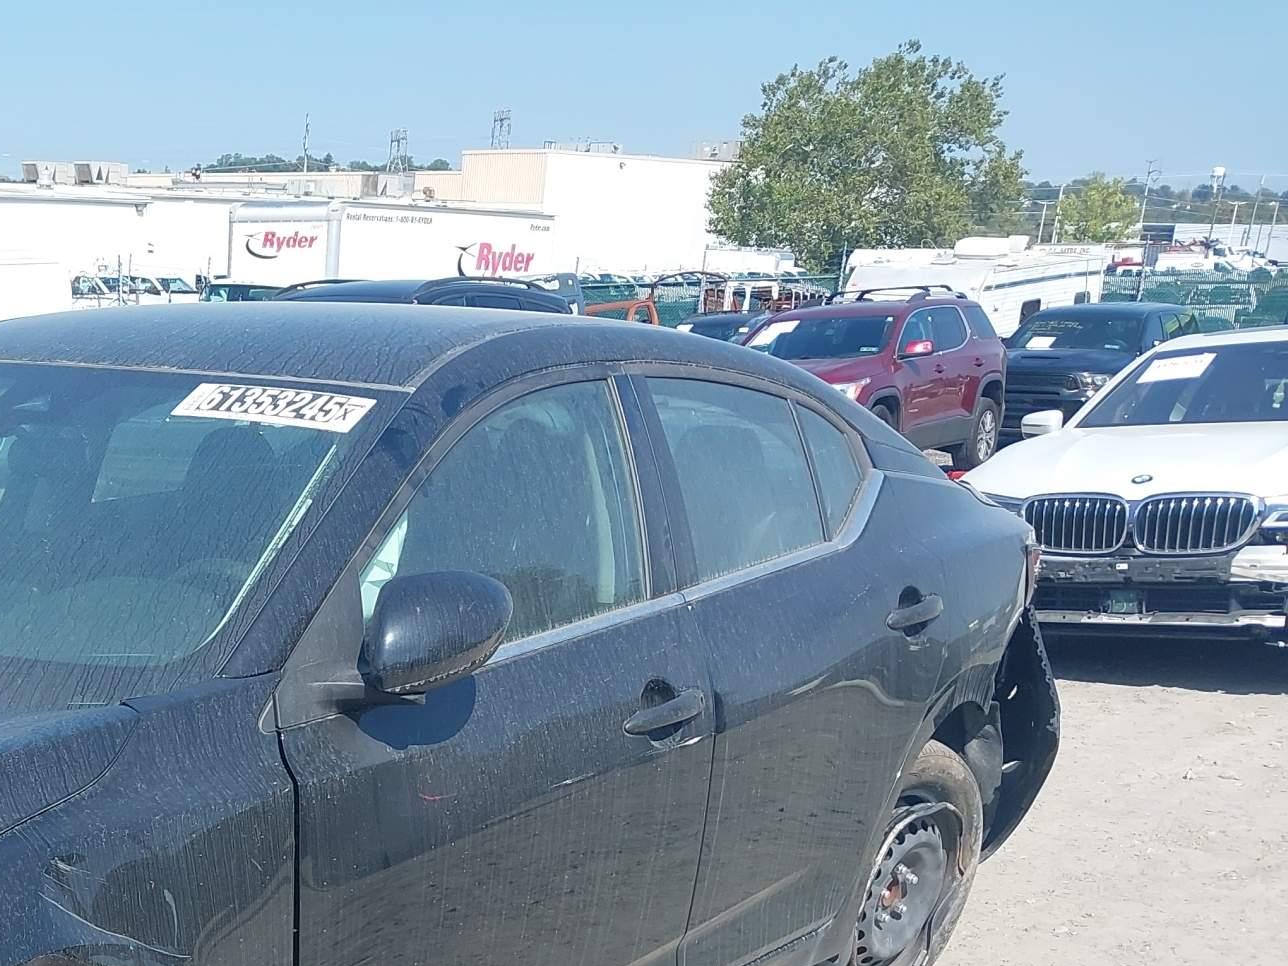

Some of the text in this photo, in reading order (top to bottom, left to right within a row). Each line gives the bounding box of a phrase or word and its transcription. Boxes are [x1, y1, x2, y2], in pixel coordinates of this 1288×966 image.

[261, 230, 318, 253] Ryder
[475, 242, 534, 277] Ryder
[200, 385, 345, 423] 61353245
